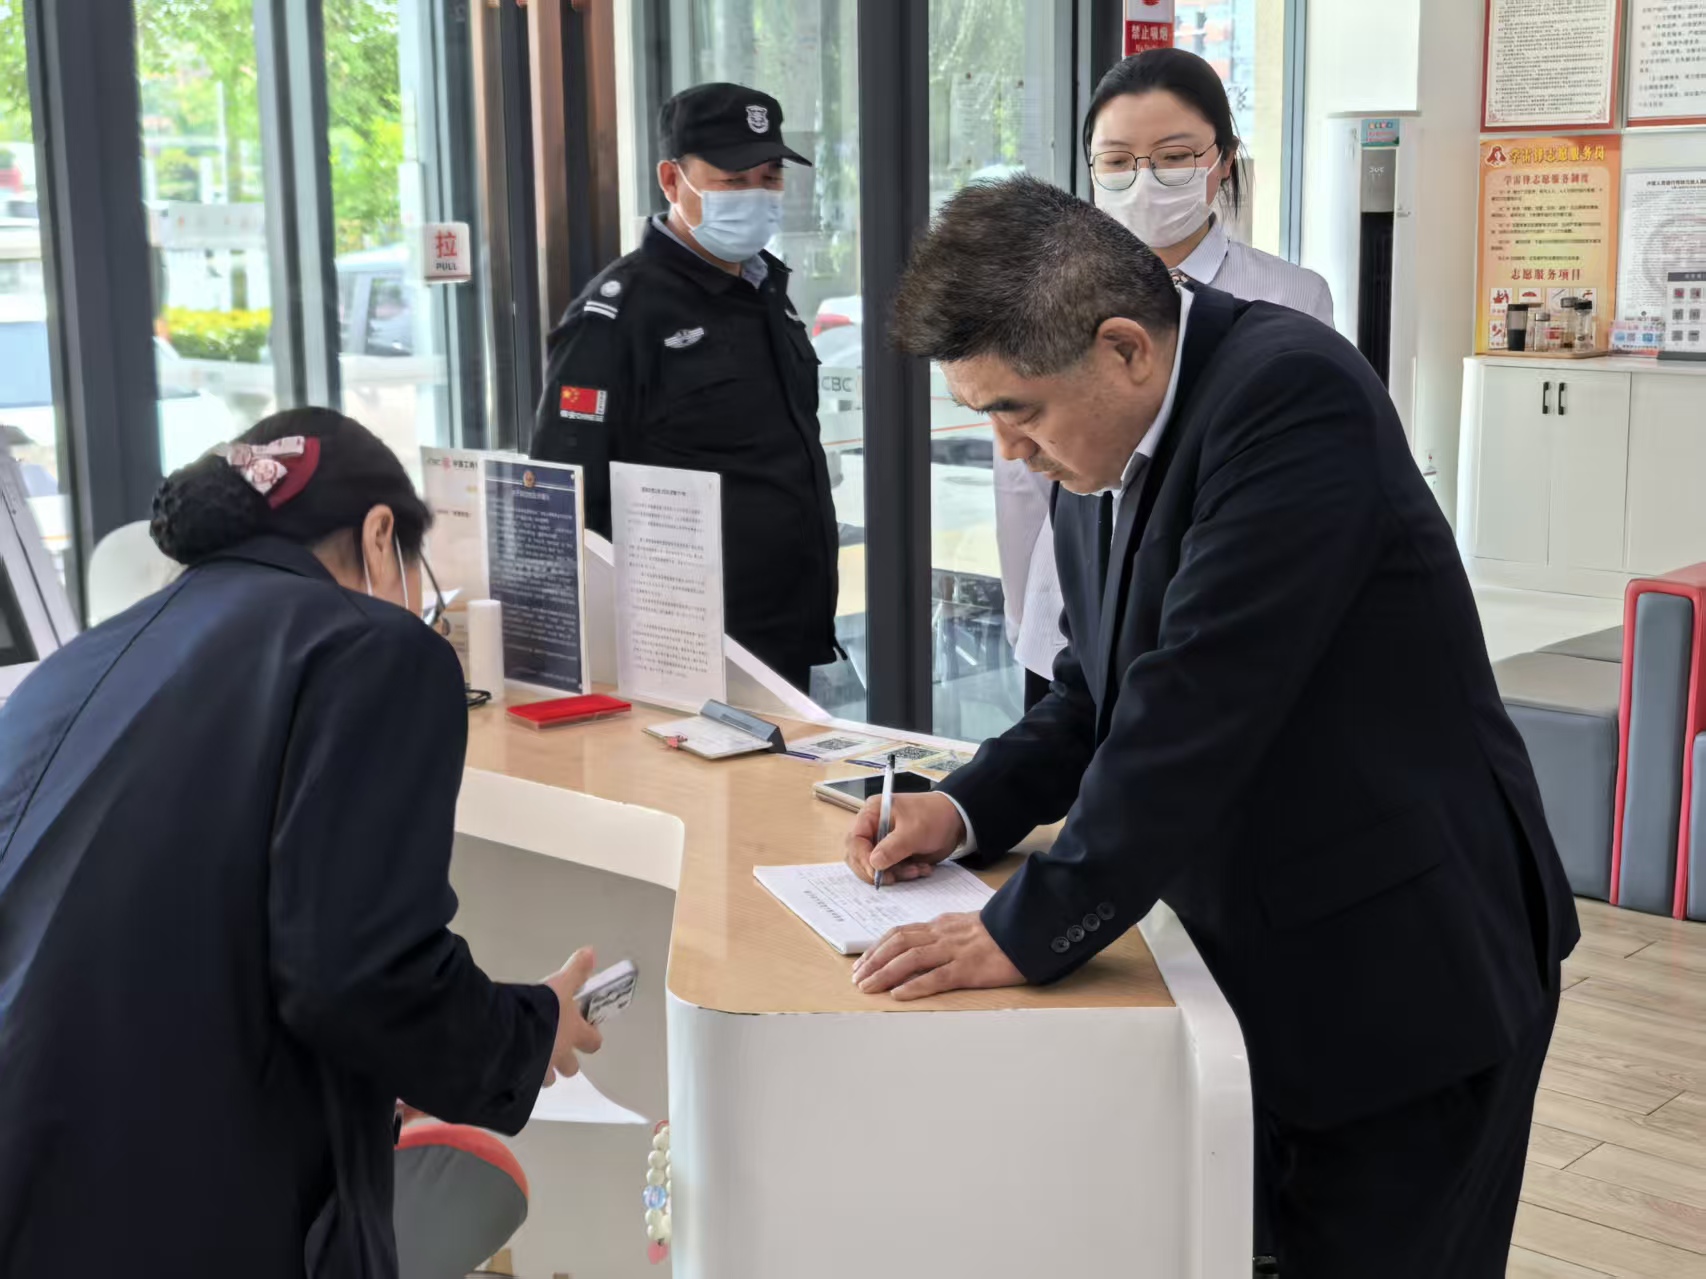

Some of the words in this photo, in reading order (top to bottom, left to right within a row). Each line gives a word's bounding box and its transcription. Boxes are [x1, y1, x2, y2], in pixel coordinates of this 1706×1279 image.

[1131, 24, 1168, 41] 禁止吸烟
[435, 230, 457, 258] 拉
[436, 262, 457, 271] PULL
[1511, 269, 1581, 281] 志愿服务项目
